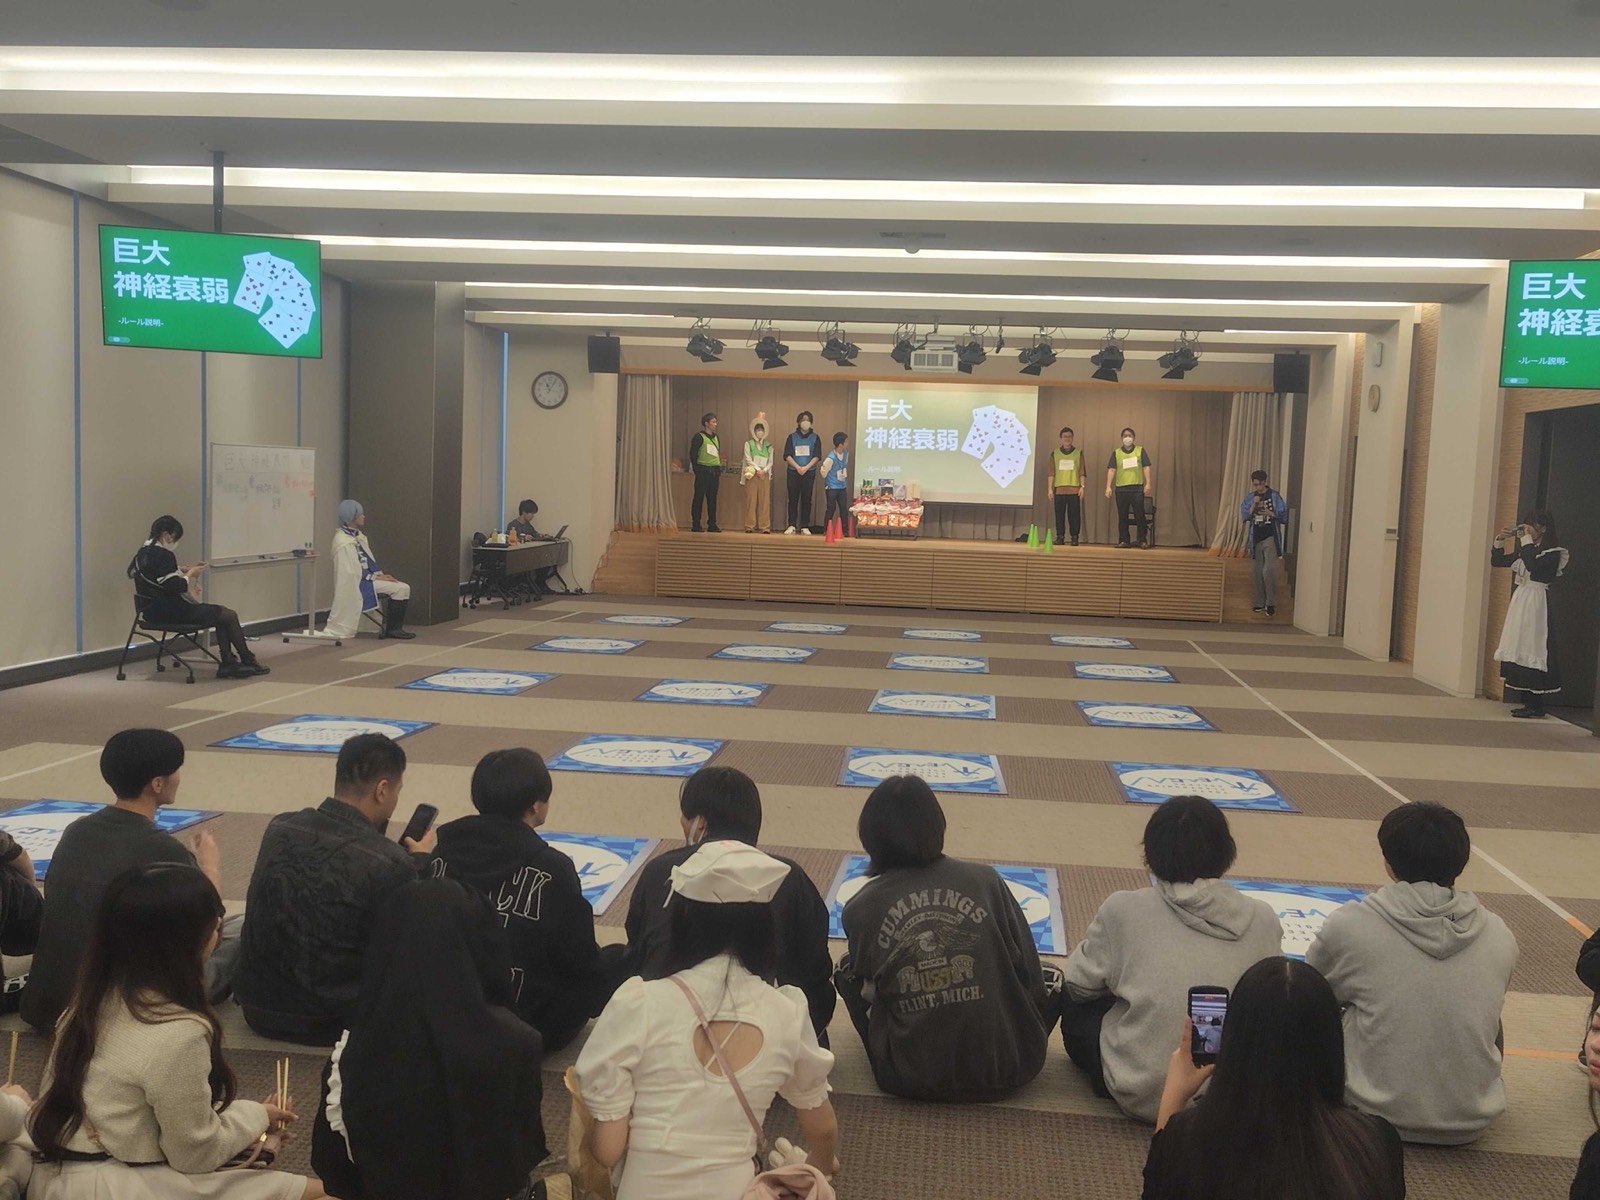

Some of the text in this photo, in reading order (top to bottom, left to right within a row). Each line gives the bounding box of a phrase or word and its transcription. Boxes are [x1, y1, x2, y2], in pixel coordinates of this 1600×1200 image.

[113, 237, 171, 267] 巨大
[113, 271, 229, 304] 神経衰弱
[1522, 272, 1586, 300] 巨大
[866, 398, 913, 421] 巨大
[864, 426, 959, 451] 神経衰弱
[877, 888, 988, 950] CUMMINGS
[898, 985, 985, 1014] FLINT, MICH.
